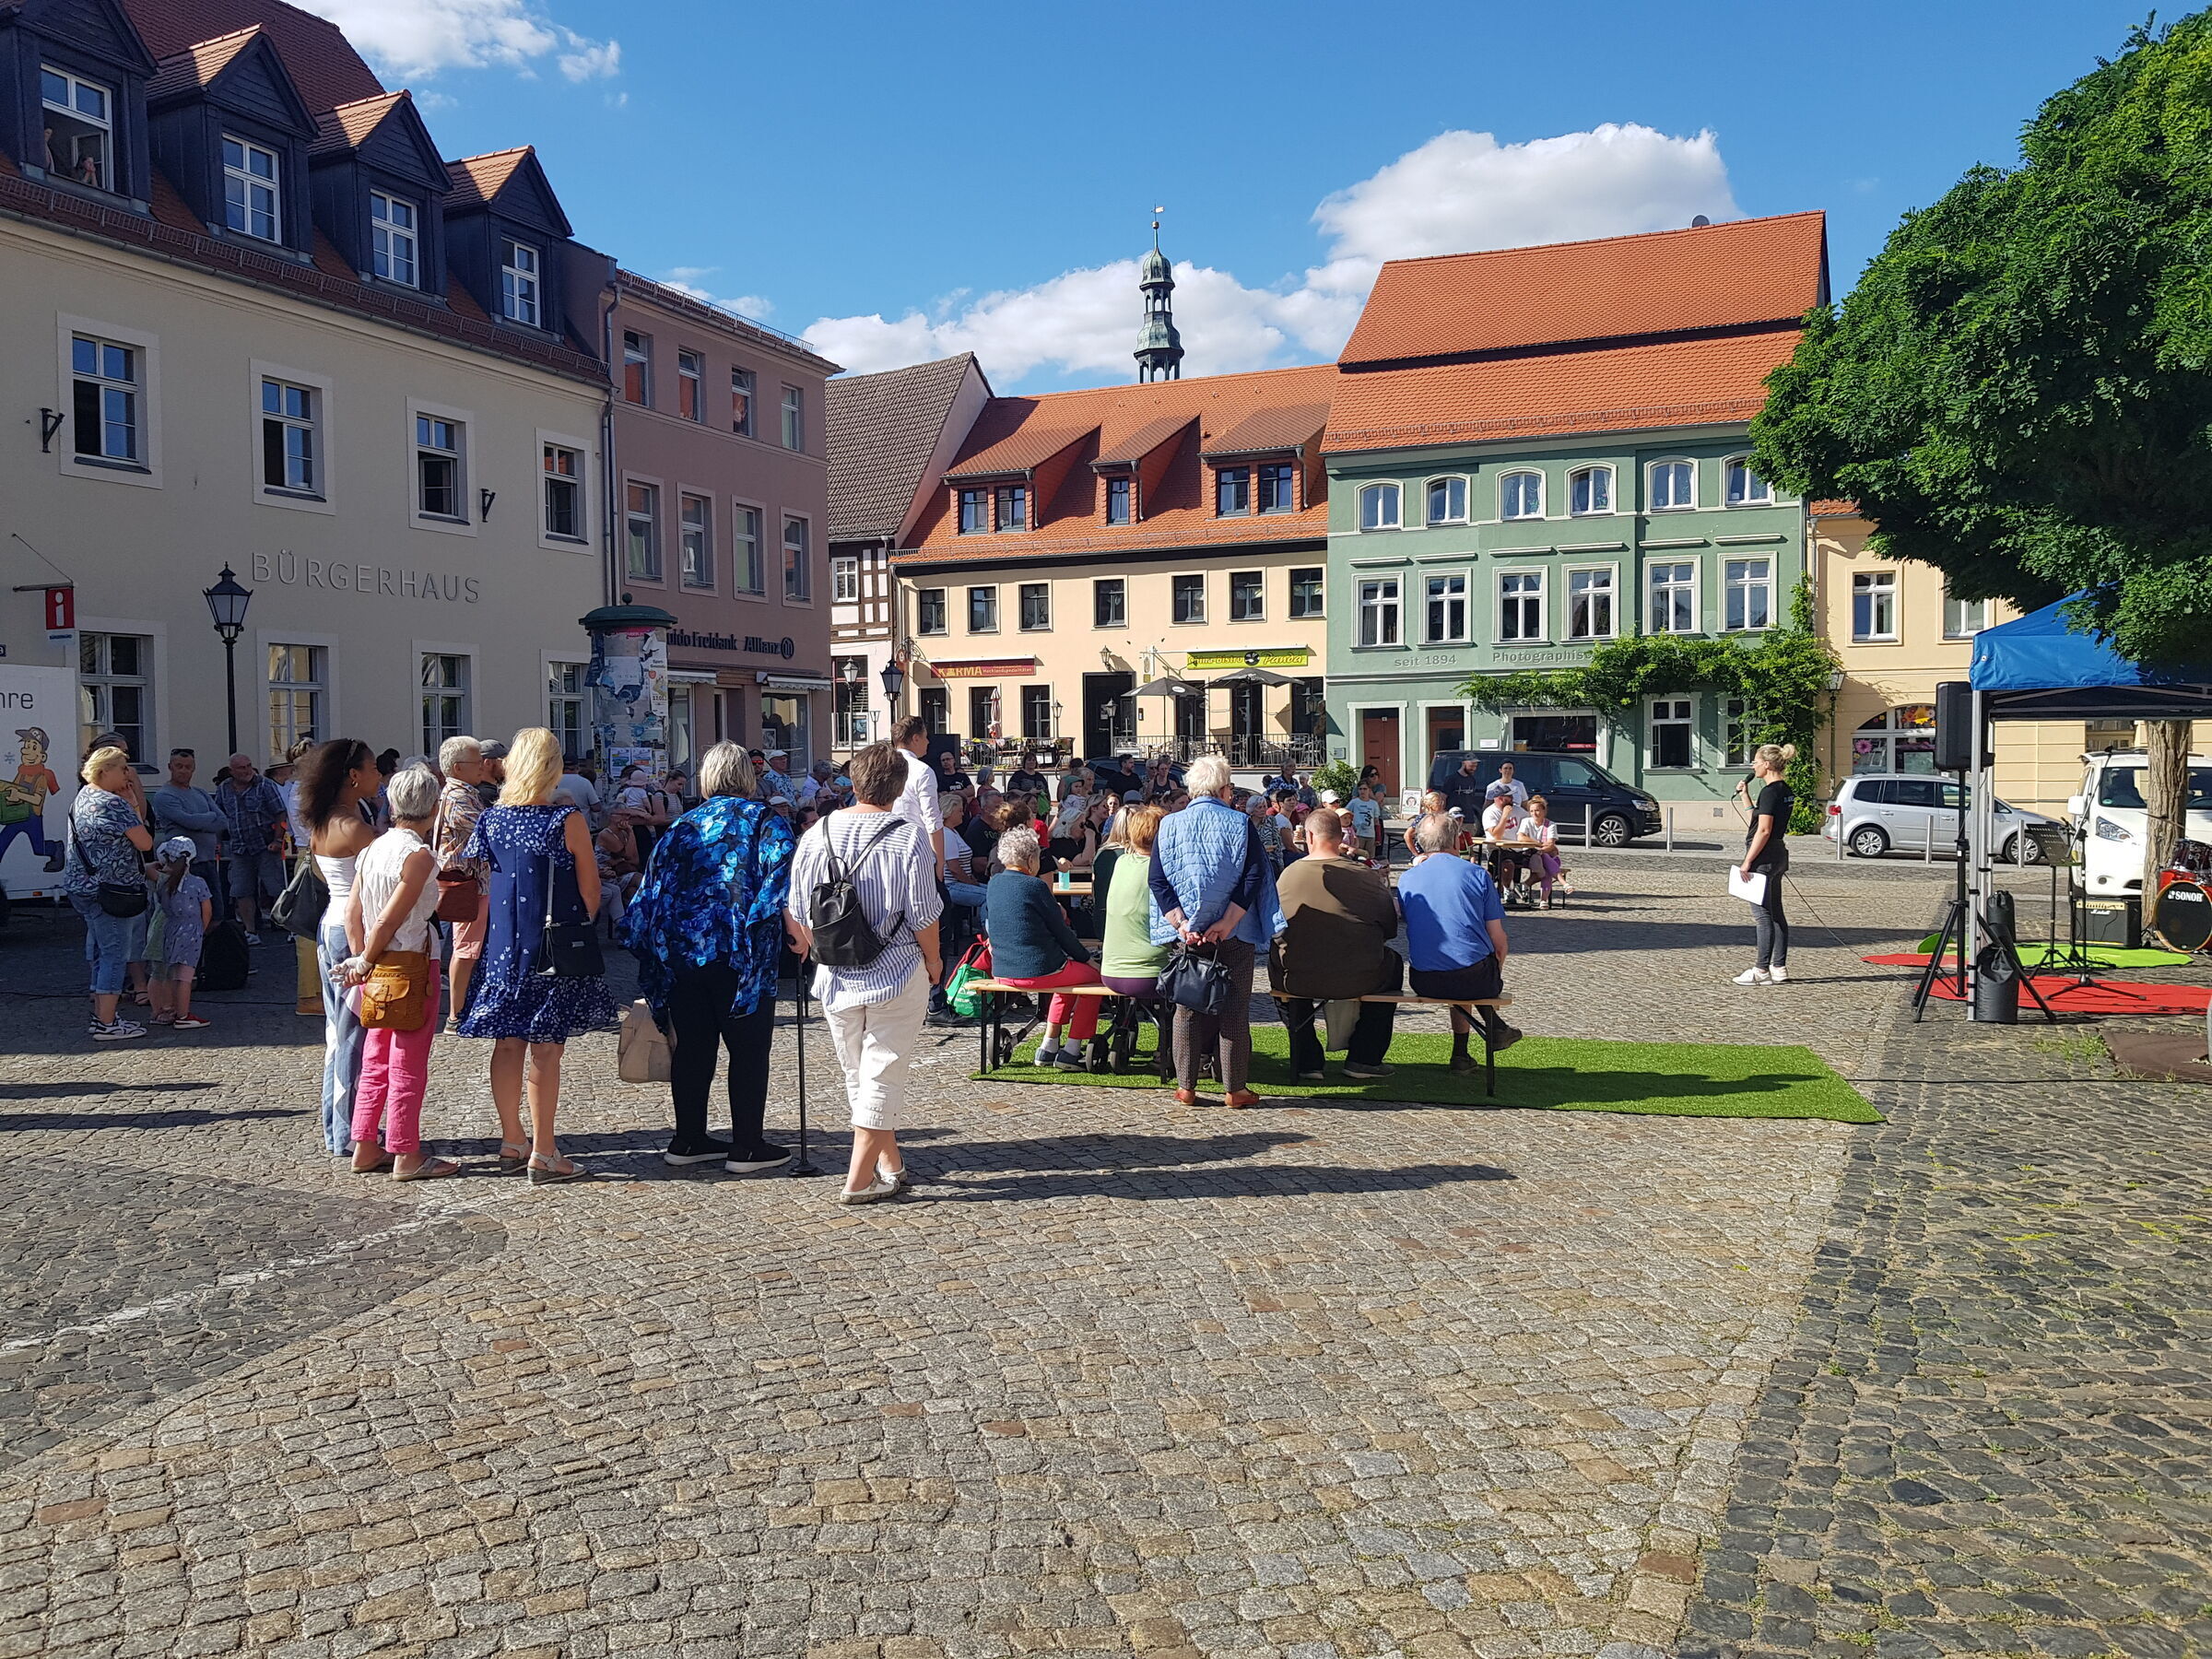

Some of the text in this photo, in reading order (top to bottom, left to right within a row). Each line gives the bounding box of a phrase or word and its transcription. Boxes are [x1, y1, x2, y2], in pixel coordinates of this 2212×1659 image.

[252, 548, 480, 604] BÜRGERHAUS
[692, 631, 738, 651] Freidank
[743, 635, 782, 655] Allianz
[1261, 651, 1302, 665] Panda
[1394, 653, 1457, 667] seit 1894
